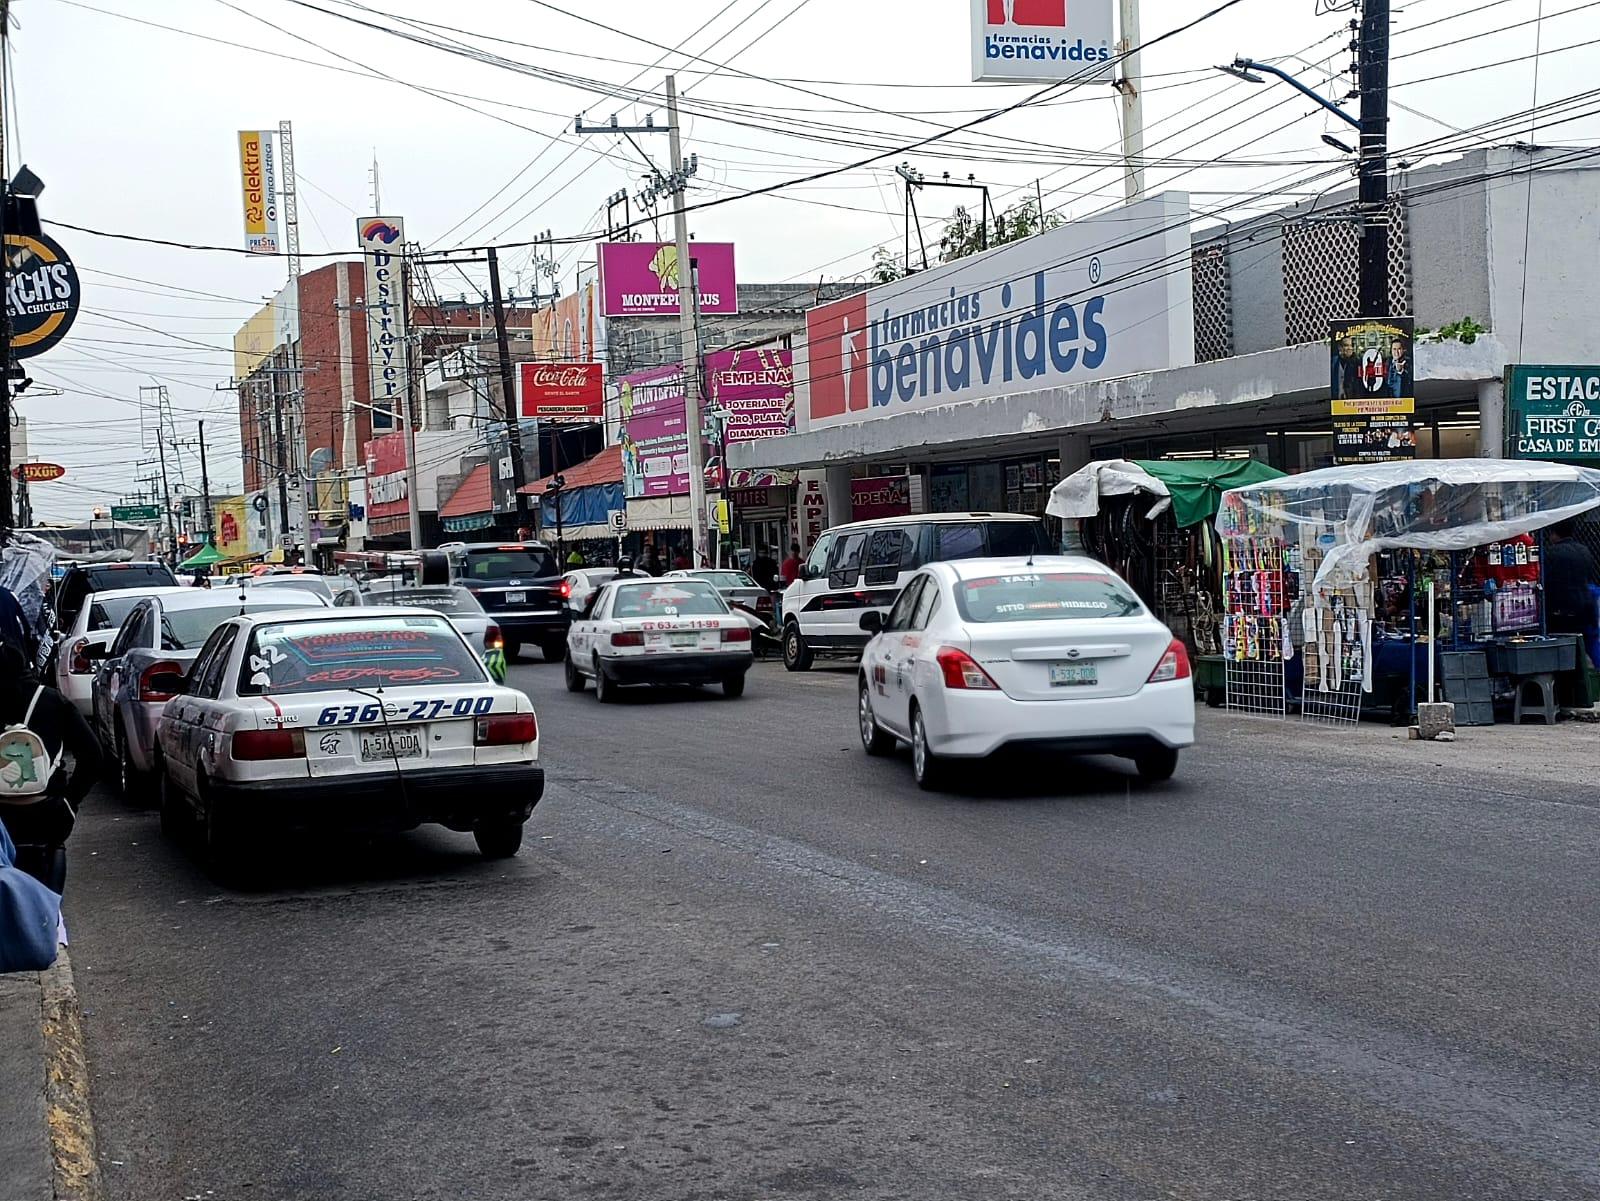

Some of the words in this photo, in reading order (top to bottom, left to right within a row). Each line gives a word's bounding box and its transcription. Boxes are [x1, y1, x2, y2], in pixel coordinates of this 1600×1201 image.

[993, 33, 1051, 44] farmacias
[985, 36, 1109, 61] benavides
[265, 143, 274, 175] Azteca
[243, 141, 262, 204] elektra
[267, 176, 276, 204] Banco
[249, 237, 276, 247] PRESTA
[27, 300, 70, 314] CHICKEN
[883, 286, 981, 344] farmacias
[373, 249, 397, 396] Destroyer
[871, 270, 1108, 407] benavides
[533, 365, 590, 387] Coca-Cola
[1526, 376, 1600, 400] ESTAC
[726, 399, 769, 410] JOYERIA
[770, 399, 784, 408] DE
[728, 414, 753, 425] ORO,
[728, 427, 787, 440] DIAMANTES
[1526, 418, 1577, 437] FIRST
[1518, 438, 1554, 453] CASA
[1556, 439, 1574, 452] DE
[24, 466, 58, 478] UXOR
[615, 515, 624, 526] E
[1001, 574, 1040, 583] TAXI
[995, 603, 1026, 613] SITIO
[1060, 600, 1108, 609] HIDALGO
[263, 714, 299, 725] TSURU
